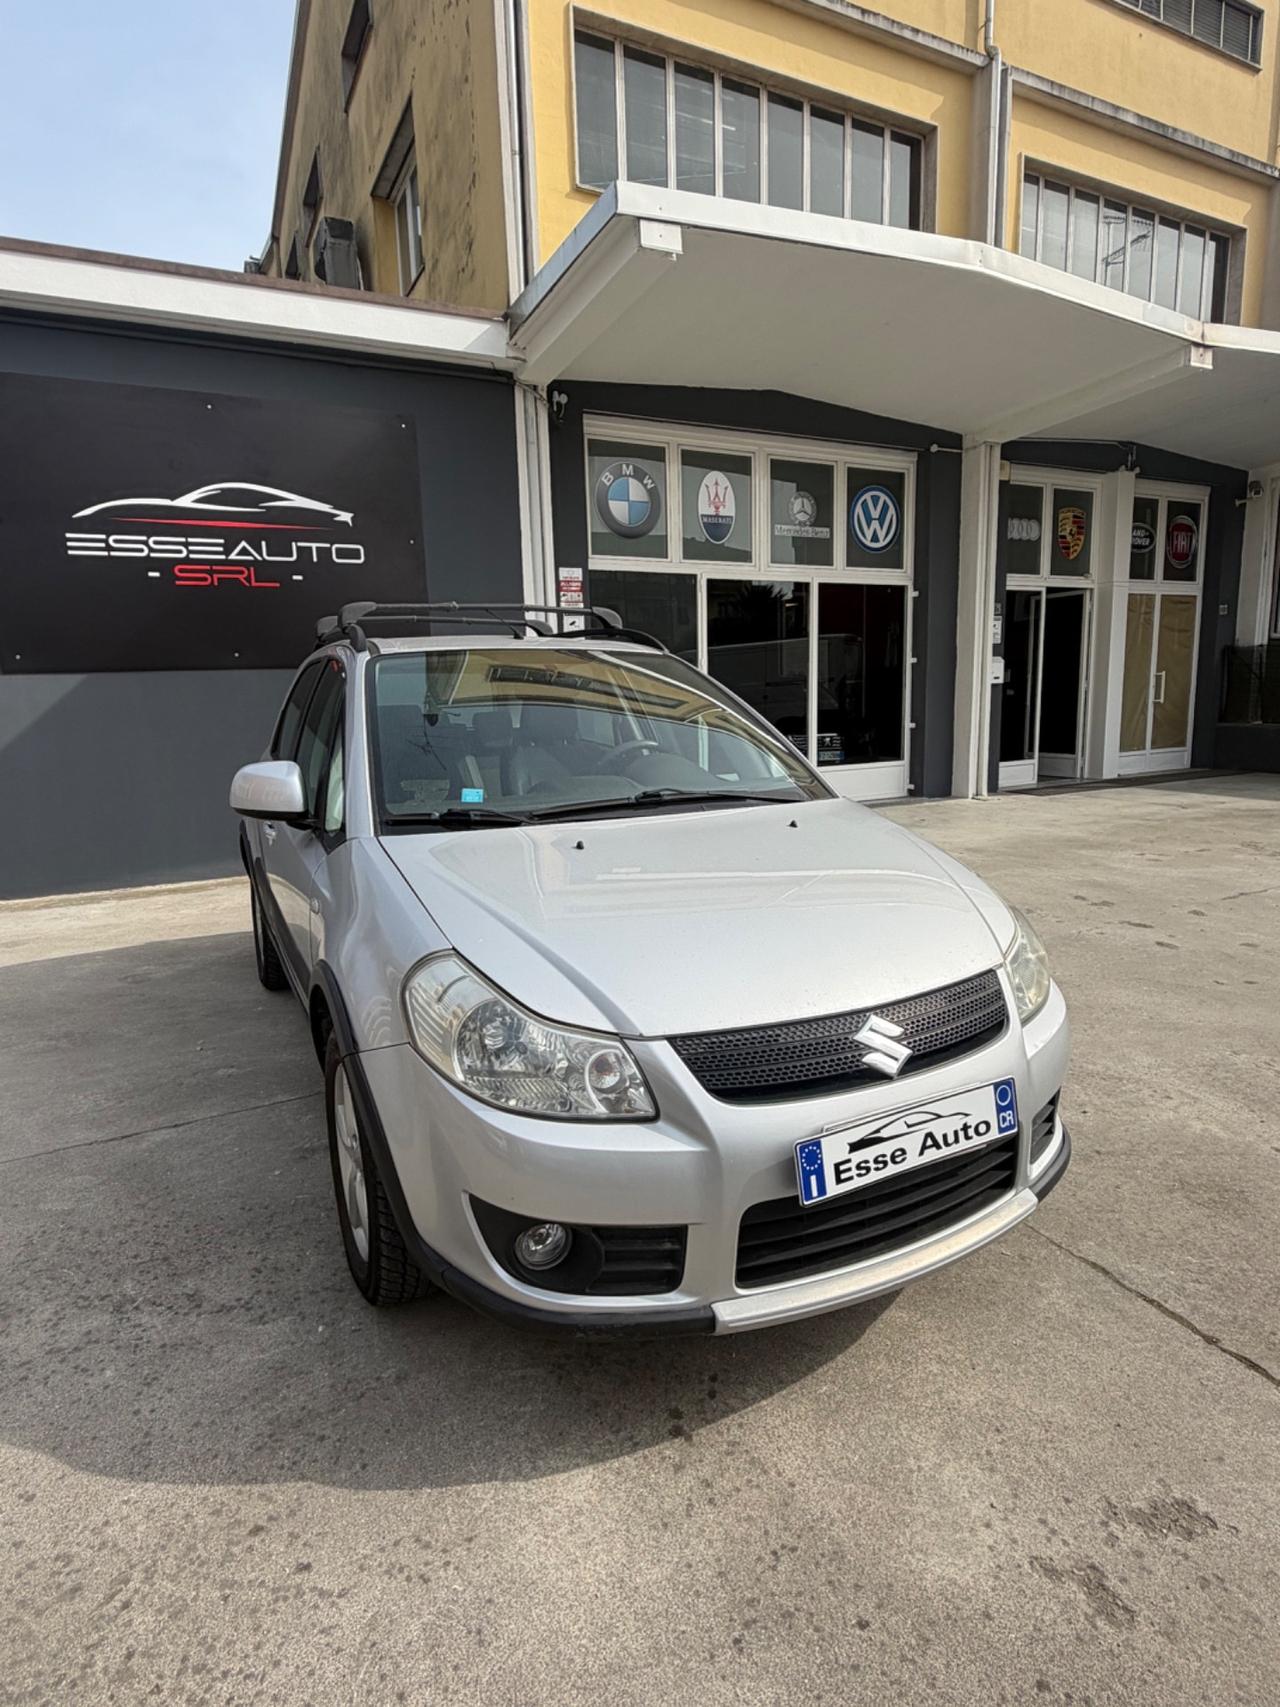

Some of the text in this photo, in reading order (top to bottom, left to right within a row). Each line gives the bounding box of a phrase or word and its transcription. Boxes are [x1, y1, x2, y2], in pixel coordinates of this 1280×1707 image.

[601, 463, 656, 489] BMW
[65, 532, 365, 564] ESSEAUTO
[1172, 530, 1191, 553] FIAT
[173, 565, 281, 587] SRL
[999, 1110, 1015, 1128] CR
[833, 1119, 992, 1186] Esse Auto
[809, 1174, 818, 1198] I
